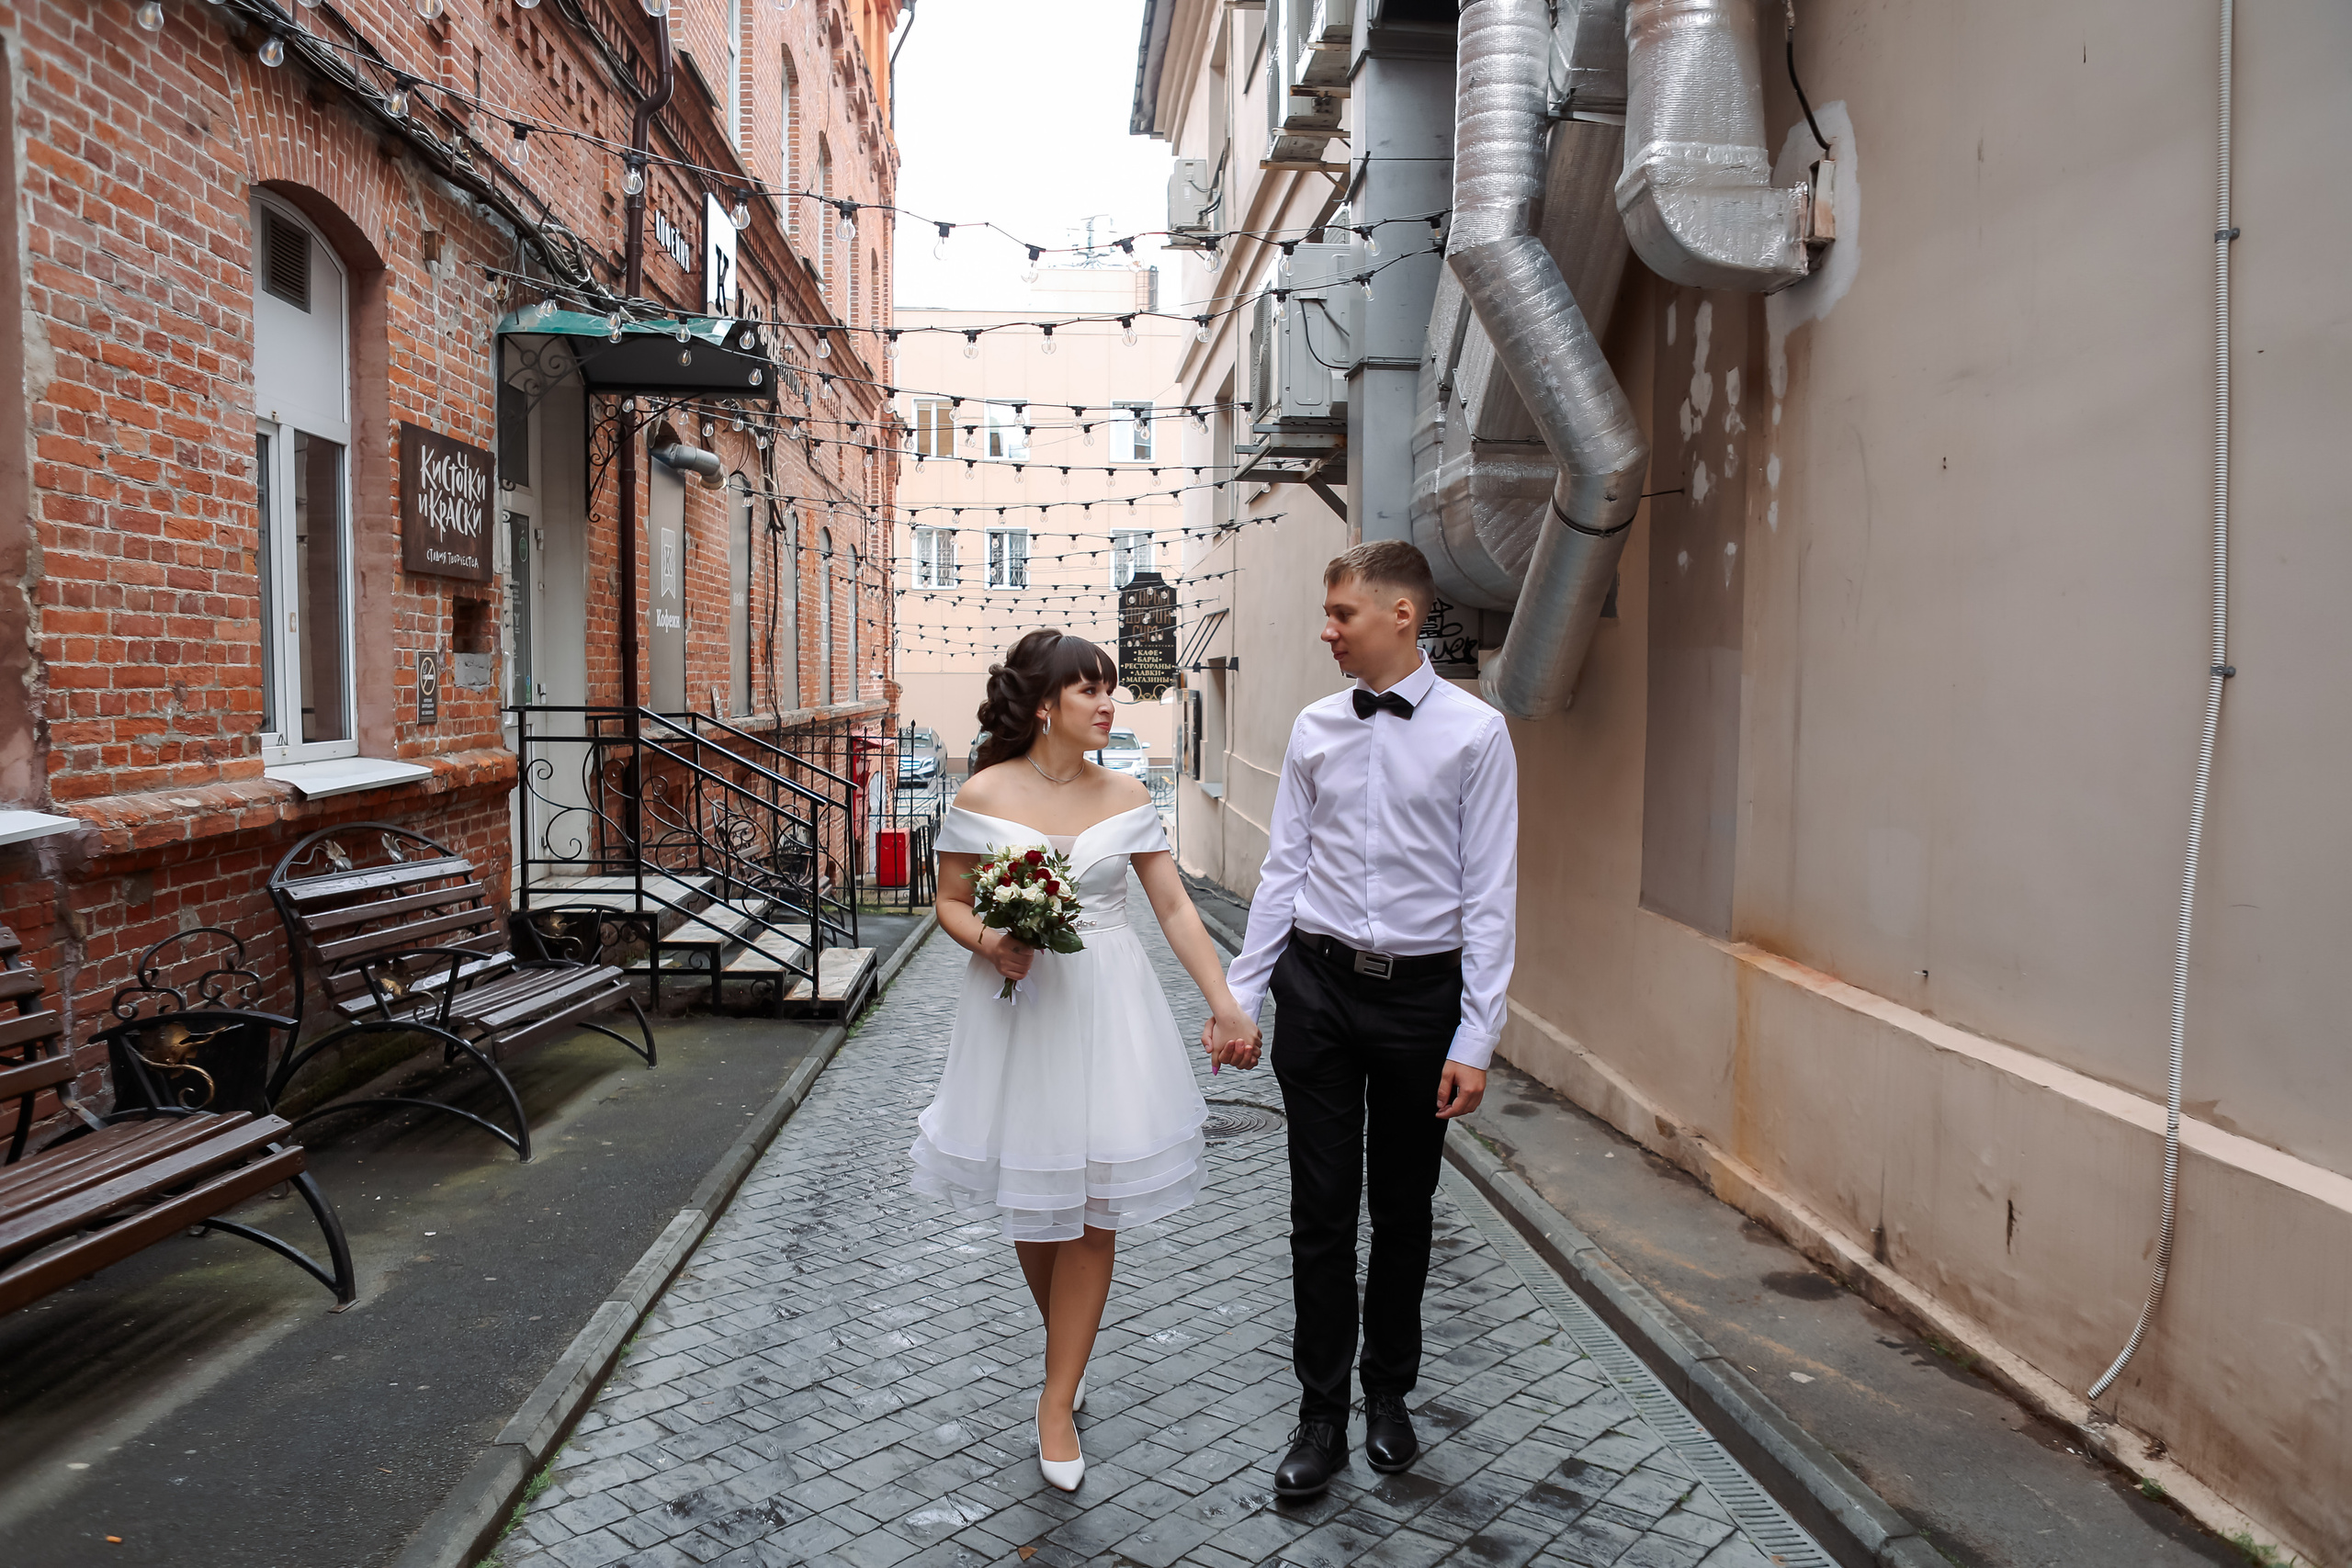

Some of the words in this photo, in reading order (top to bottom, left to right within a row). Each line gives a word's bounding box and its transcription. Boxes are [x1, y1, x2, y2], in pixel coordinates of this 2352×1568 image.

[655, 209, 690, 274] КОФЕЙНЯ
[420, 445, 486, 502] КИСТОЧКИ
[429, 488, 482, 543] КРАСКИ
